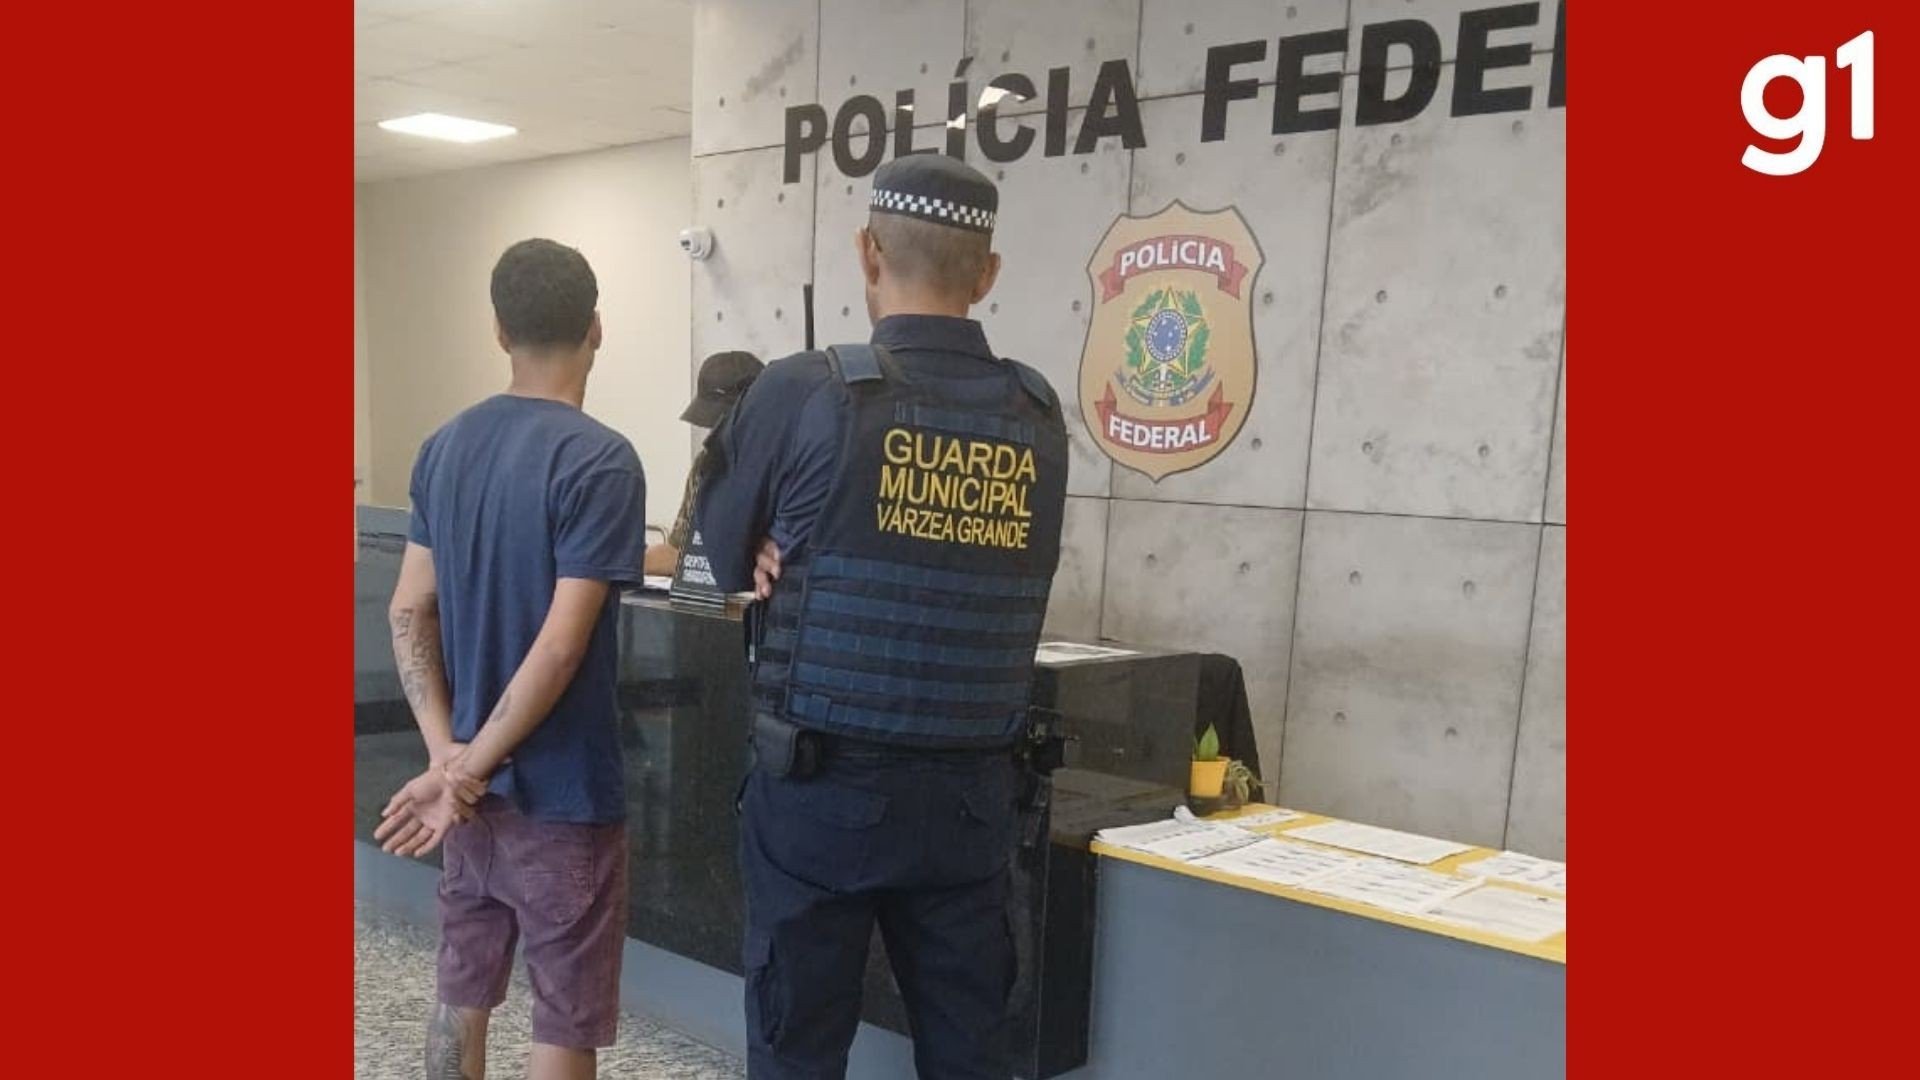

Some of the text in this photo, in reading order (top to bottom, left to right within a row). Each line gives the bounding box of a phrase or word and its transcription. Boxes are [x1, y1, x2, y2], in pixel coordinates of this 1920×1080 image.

[784, 0, 1566, 184] POLÍCIA FEDE
[884, 428, 1037, 483] GUARDA
[1109, 414, 1211, 449] FEDERAL
[879, 464, 1032, 518] MUNICIPAL
[877, 501, 1030, 549] VÁRZEA GRANDE
